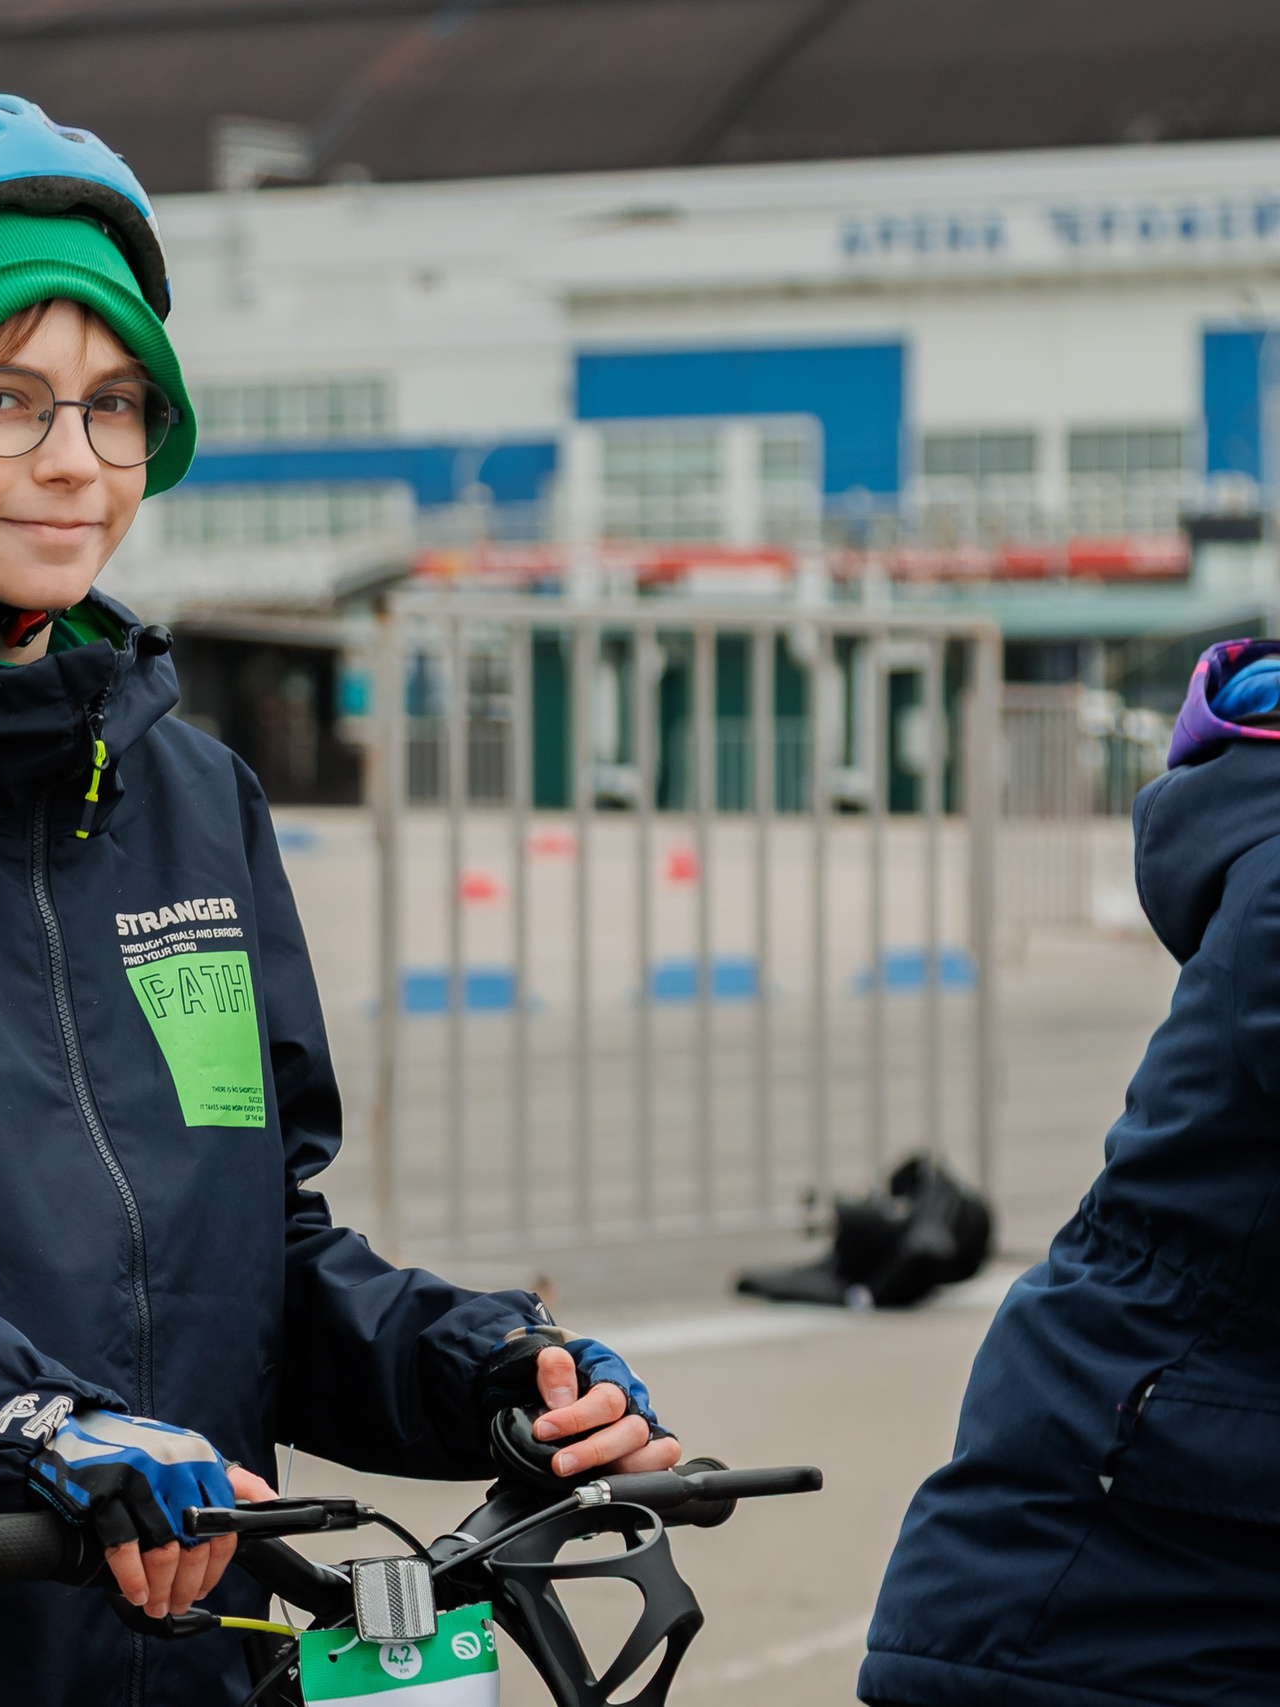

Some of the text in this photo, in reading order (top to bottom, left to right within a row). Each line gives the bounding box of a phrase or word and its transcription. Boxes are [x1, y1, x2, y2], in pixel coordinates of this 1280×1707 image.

[115, 897, 238, 936] STRANGER
[120, 927, 243, 954] THROUGH TRIALS AND ERRORS
[122, 941, 197, 967] FIND YOUR ROAD
[138, 964, 251, 1019] PATH
[387, 1645, 414, 1666] 4,2
